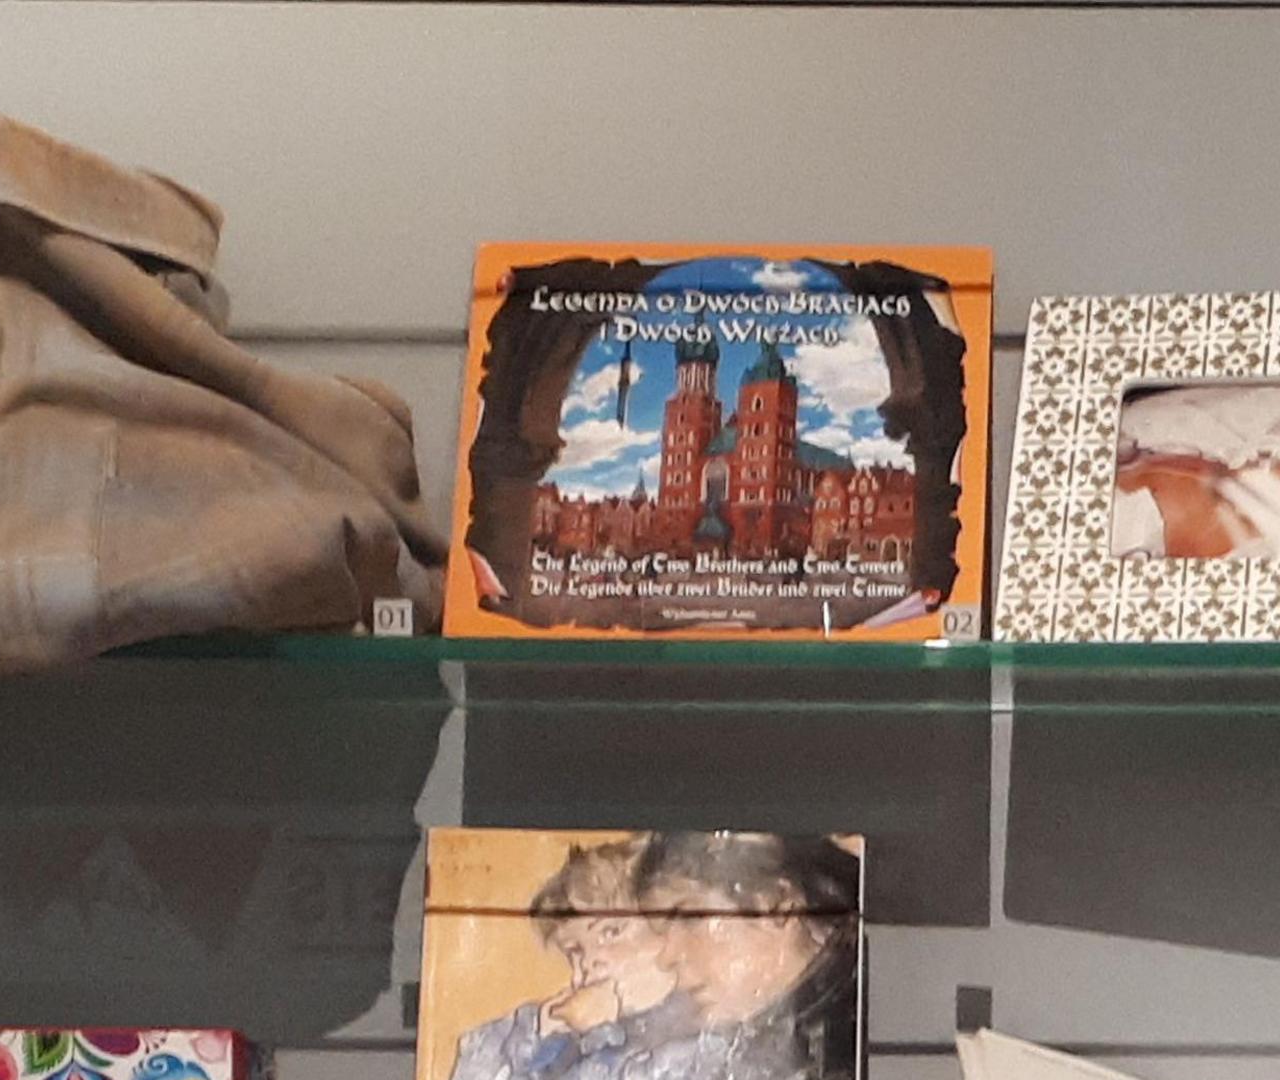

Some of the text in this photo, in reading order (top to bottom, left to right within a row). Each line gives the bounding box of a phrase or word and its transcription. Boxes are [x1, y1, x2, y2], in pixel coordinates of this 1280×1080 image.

[570, 551, 627, 575] Legend
[632, 553, 650, 573] of
[652, 552, 689, 573] Two
[695, 551, 763, 574] Brothers
[530, 573, 561, 596] Die
[567, 575, 633, 598] Legende
[378, 608, 408, 629] 01
[943, 613, 973, 635] 02
